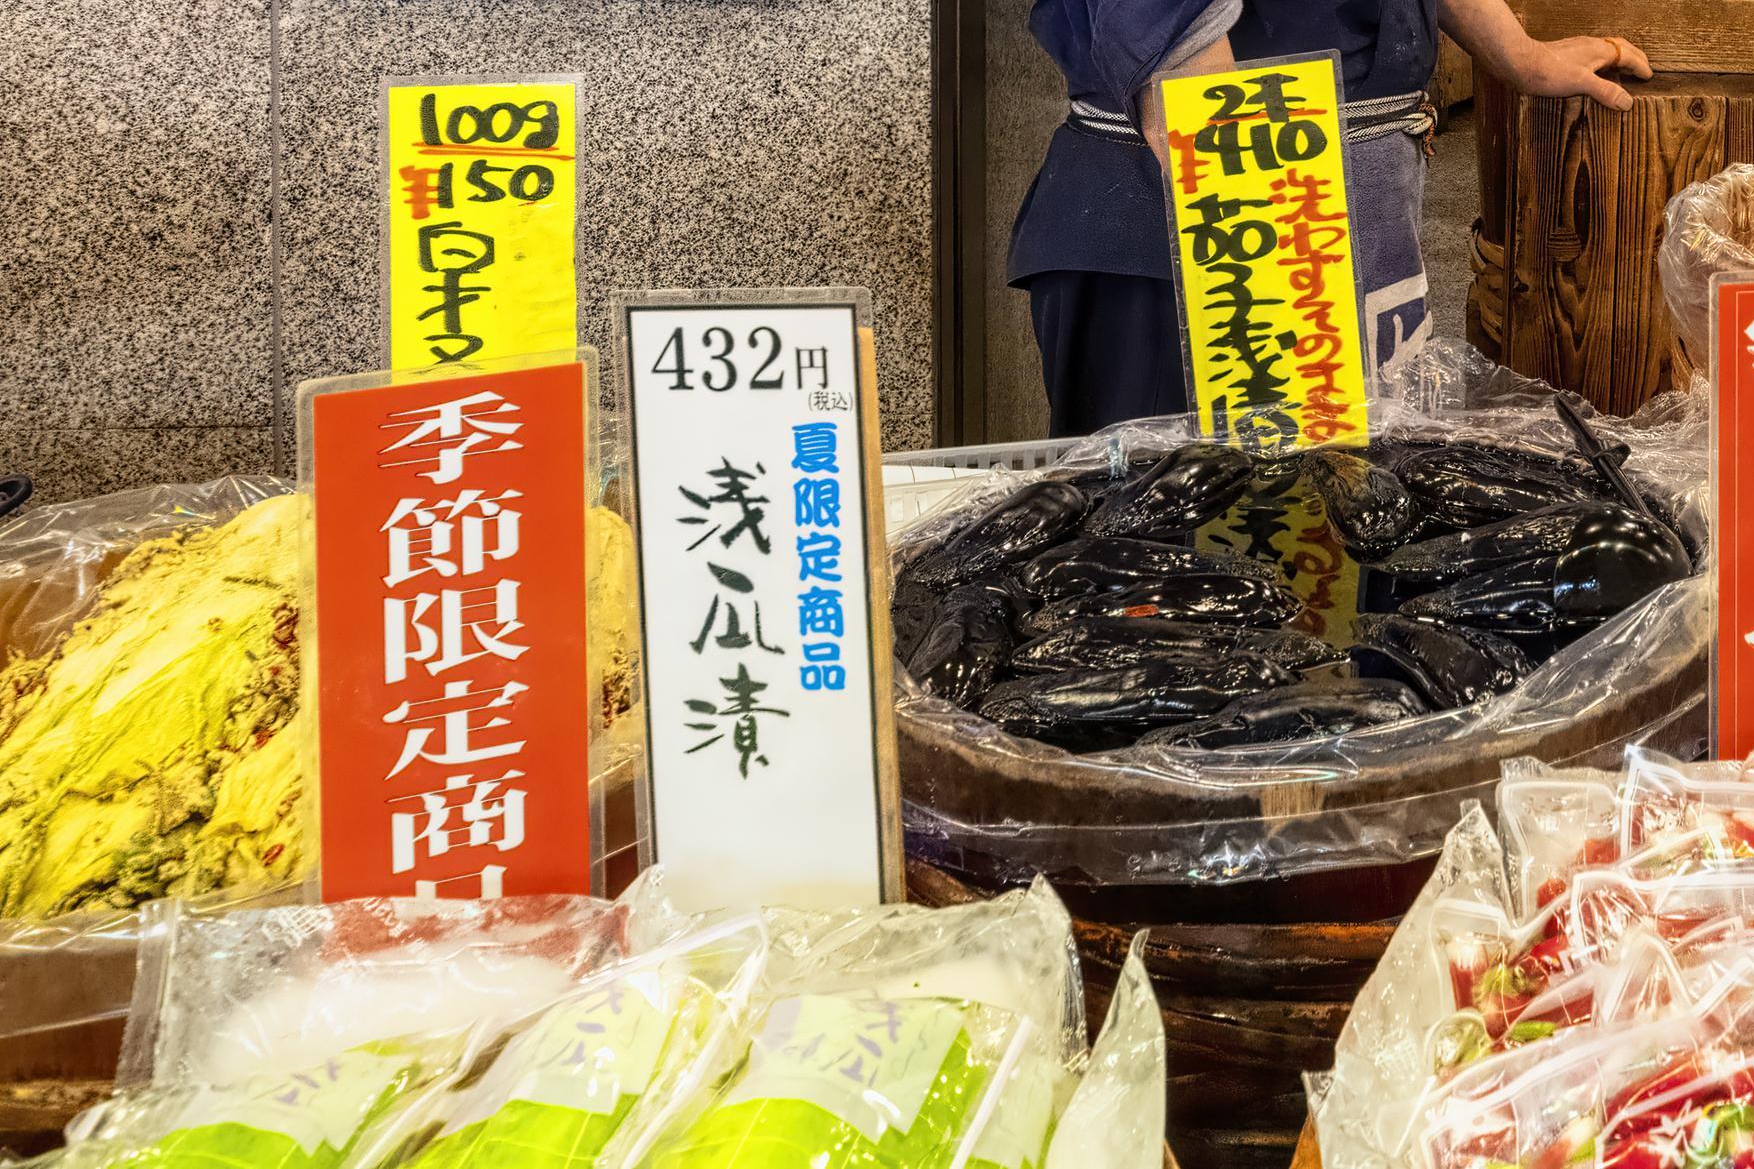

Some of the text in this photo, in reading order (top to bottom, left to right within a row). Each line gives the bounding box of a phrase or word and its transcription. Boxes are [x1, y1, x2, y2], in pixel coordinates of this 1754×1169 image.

[398, 159, 555, 220] ¥150
[651, 325, 831, 392] 432円
[806, 389, 855, 413] (税込)
[792, 422, 847, 693] 夏限定商品
[676, 455, 791, 781] 浅瓜漬
